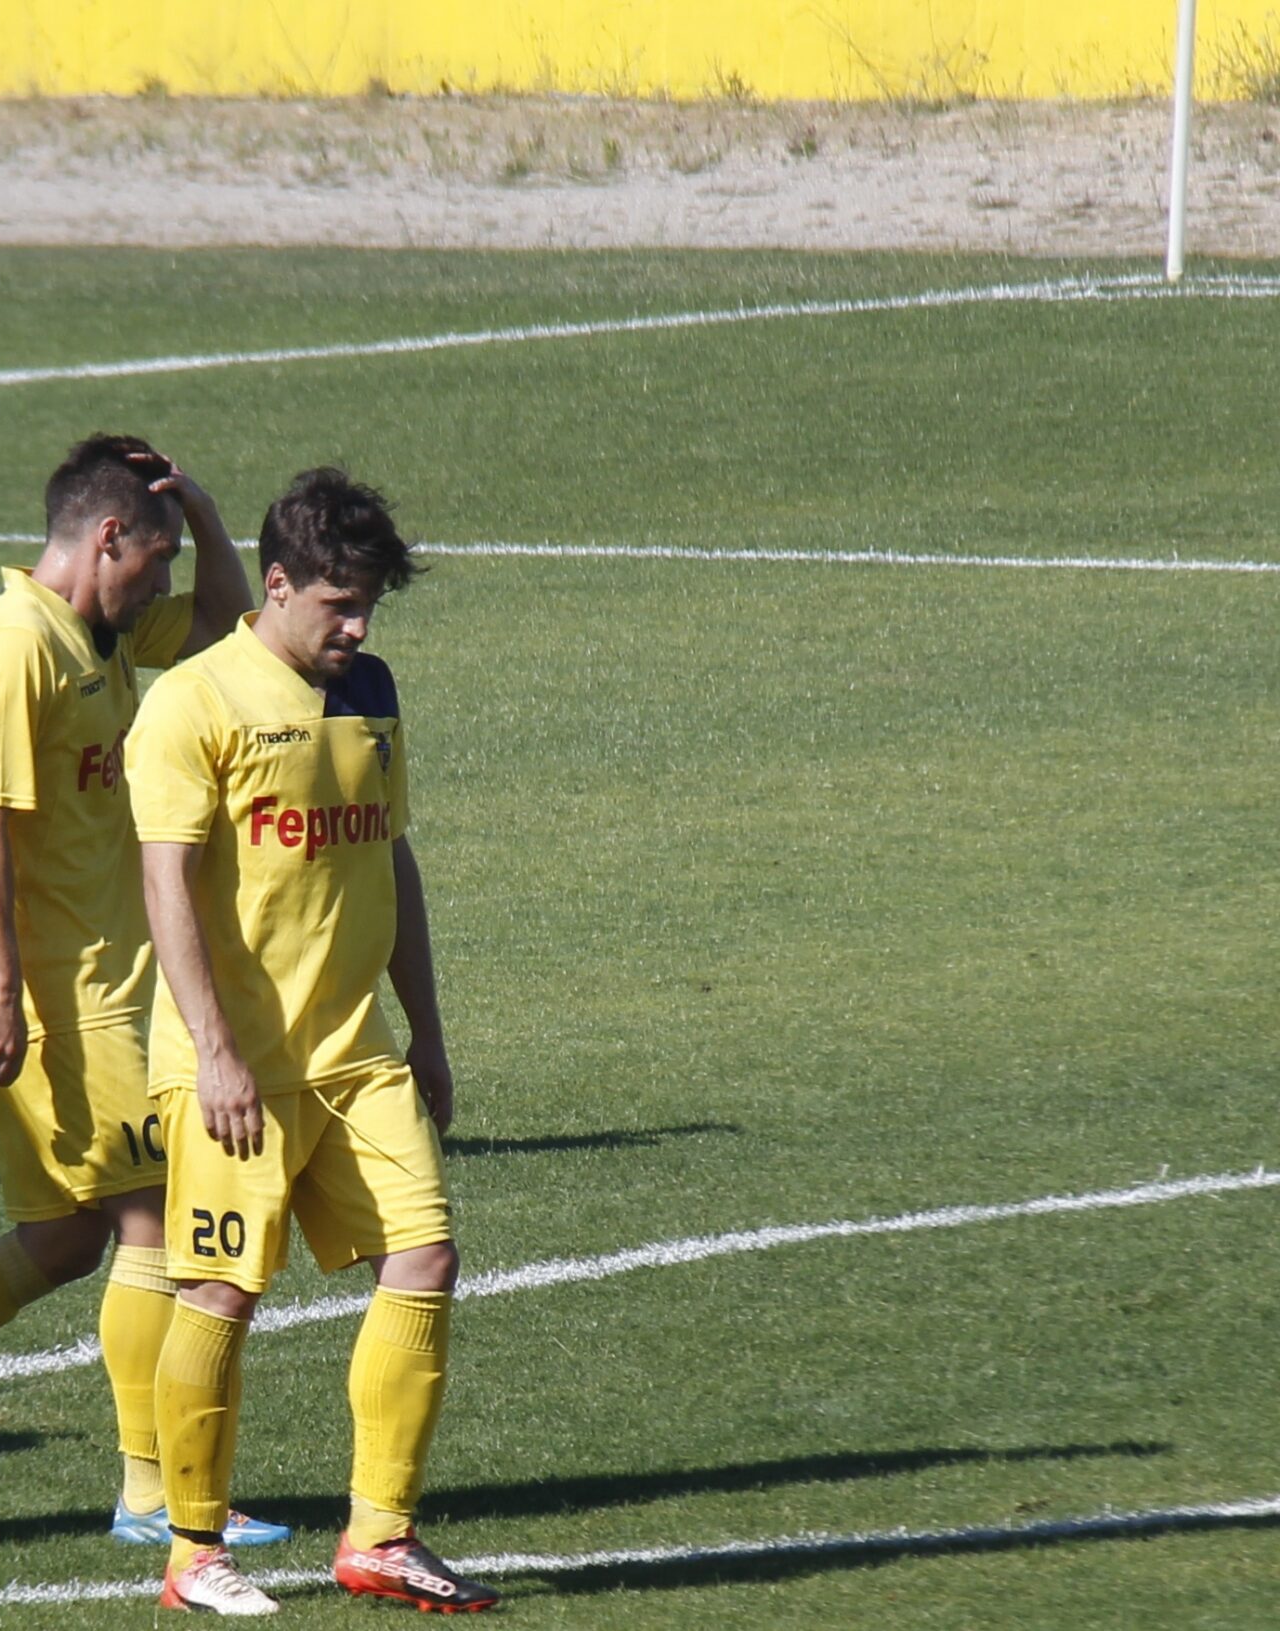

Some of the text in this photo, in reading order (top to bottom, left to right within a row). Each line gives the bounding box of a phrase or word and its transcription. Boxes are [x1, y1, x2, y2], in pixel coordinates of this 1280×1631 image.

[257, 728, 312, 745] macron
[121, 1113, 167, 1167] 10
[192, 1207, 246, 1259] 20
